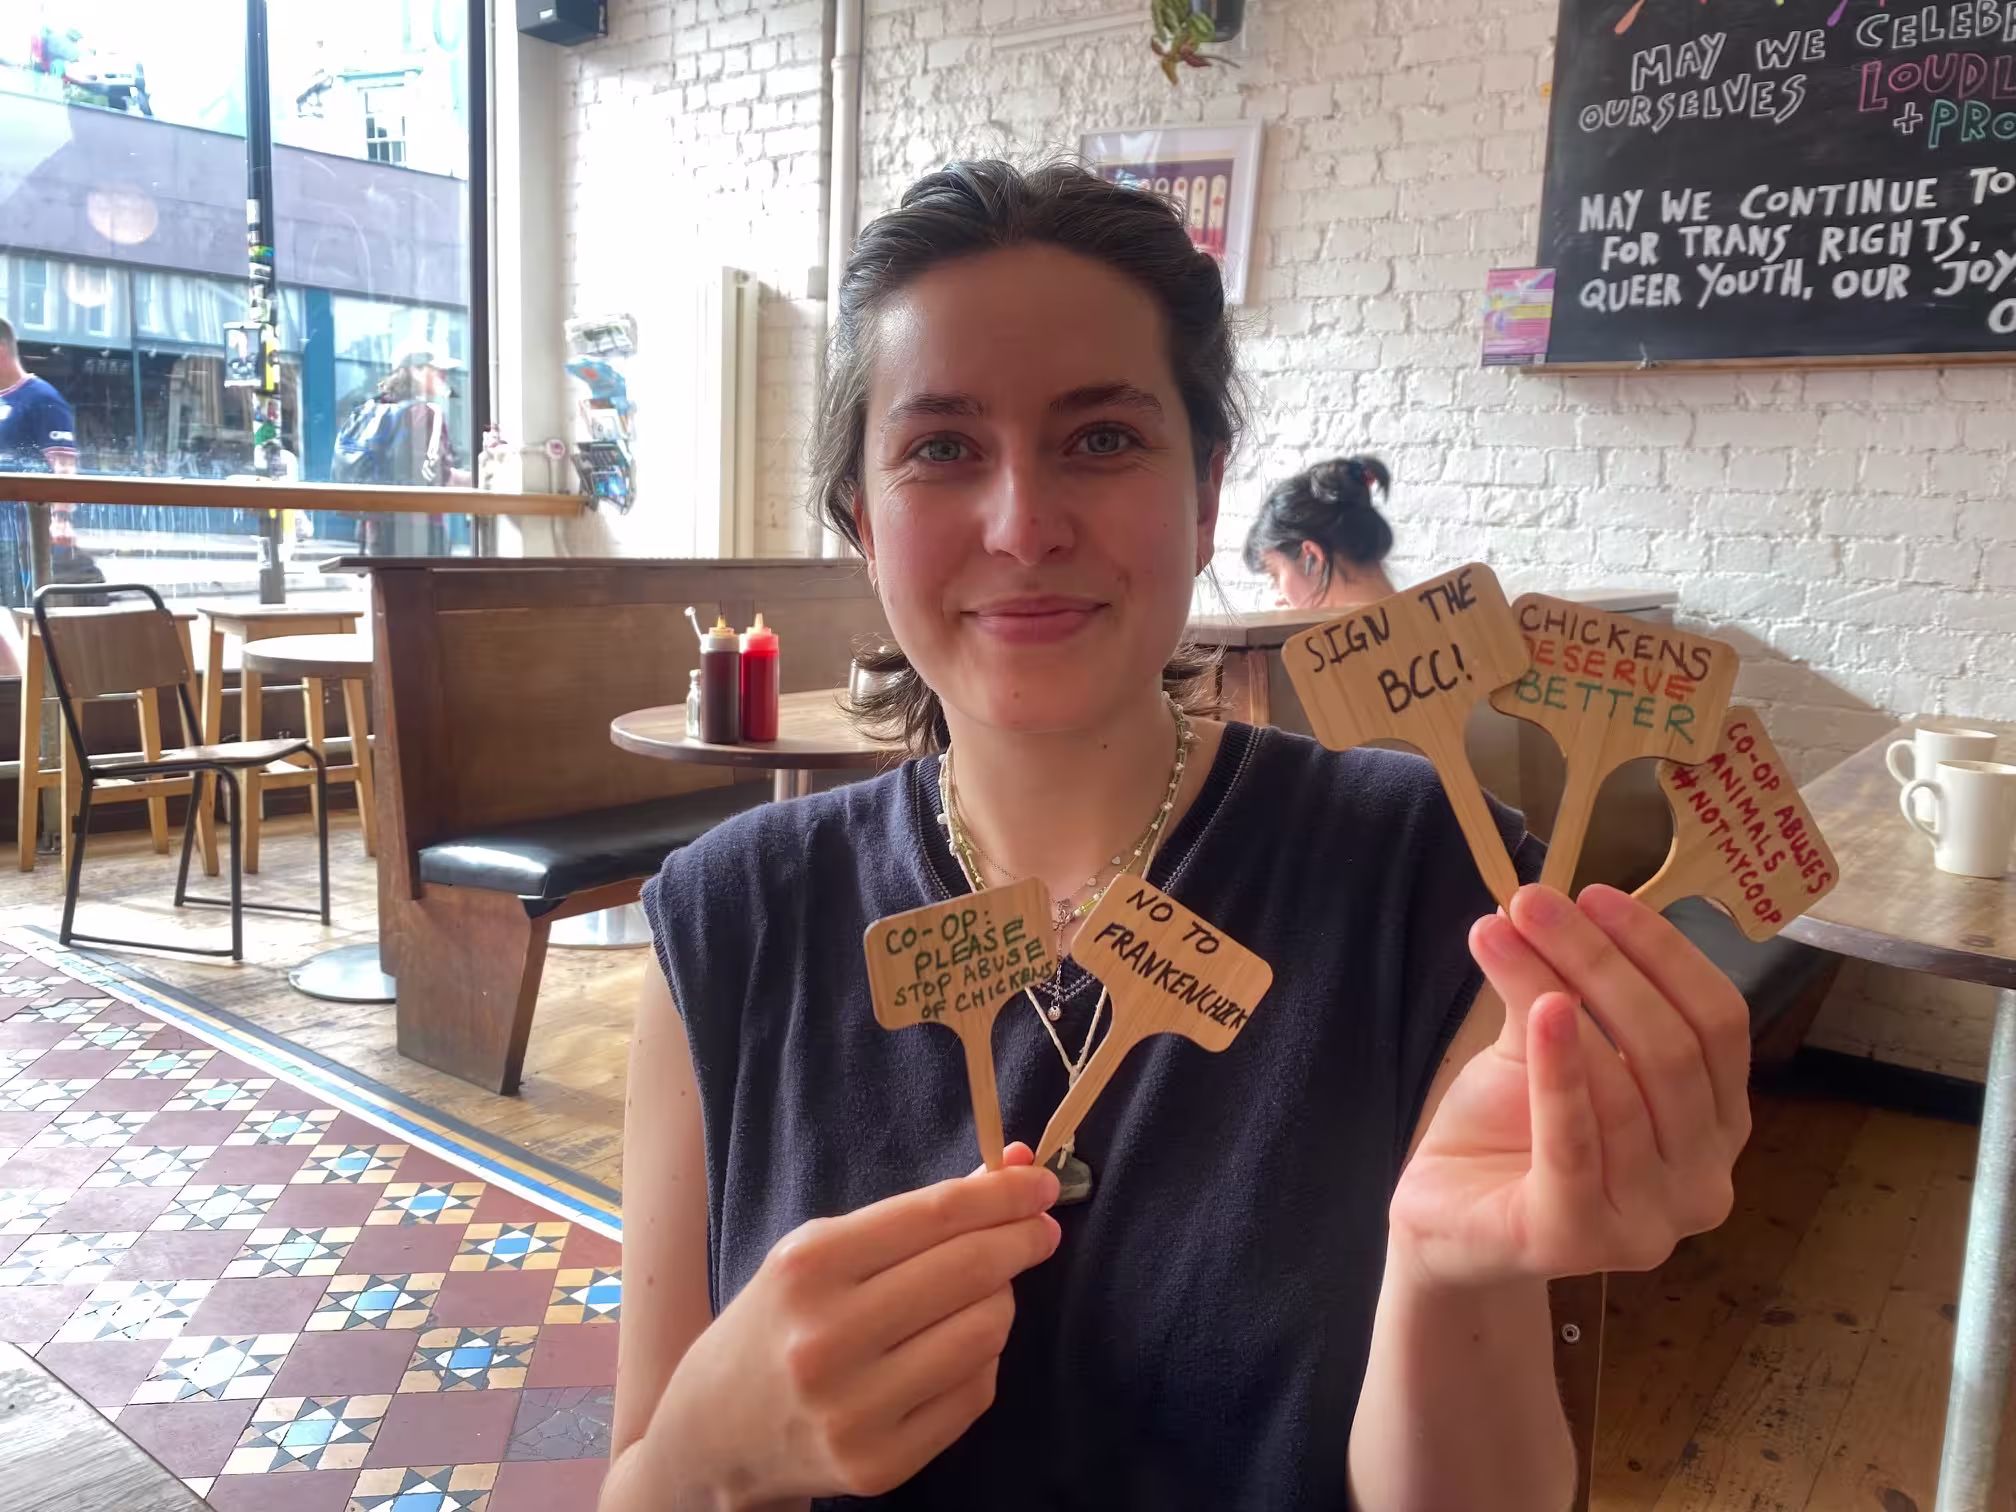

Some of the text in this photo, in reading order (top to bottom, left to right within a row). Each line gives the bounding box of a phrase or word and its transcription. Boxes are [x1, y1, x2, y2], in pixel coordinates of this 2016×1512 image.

[1578, 52, 2016, 134] OURSELVES LOUDL
[1630, 31, 1727, 93] MAY
[1756, 29, 1826, 71] WE
[1579, 166, 2016, 233] MAY WE CONTINUE TO
[1601, 214, 1981, 272] FOR TRANS RIGHTS.
[1579, 272, 1682, 312] QUEER
[1696, 258, 1814, 310] YOUTH,
[1831, 262, 1911, 301] OUR
[1304, 568, 1477, 673] SIGN THE
[1519, 604, 1712, 681] CHICKENS
[1377, 643, 1473, 713] BCC!
[1515, 669, 1696, 745] BETTER
[1707, 752, 1786, 873] ANIMALS
[1727, 722, 1832, 895] CO-OP ABUSES
[914, 916, 1027, 980] PLEASE
[1126, 889, 1220, 954] NO TO
[894, 937, 1045, 1007] STOP ABUSE
[921, 1000, 948, 1019] OF
